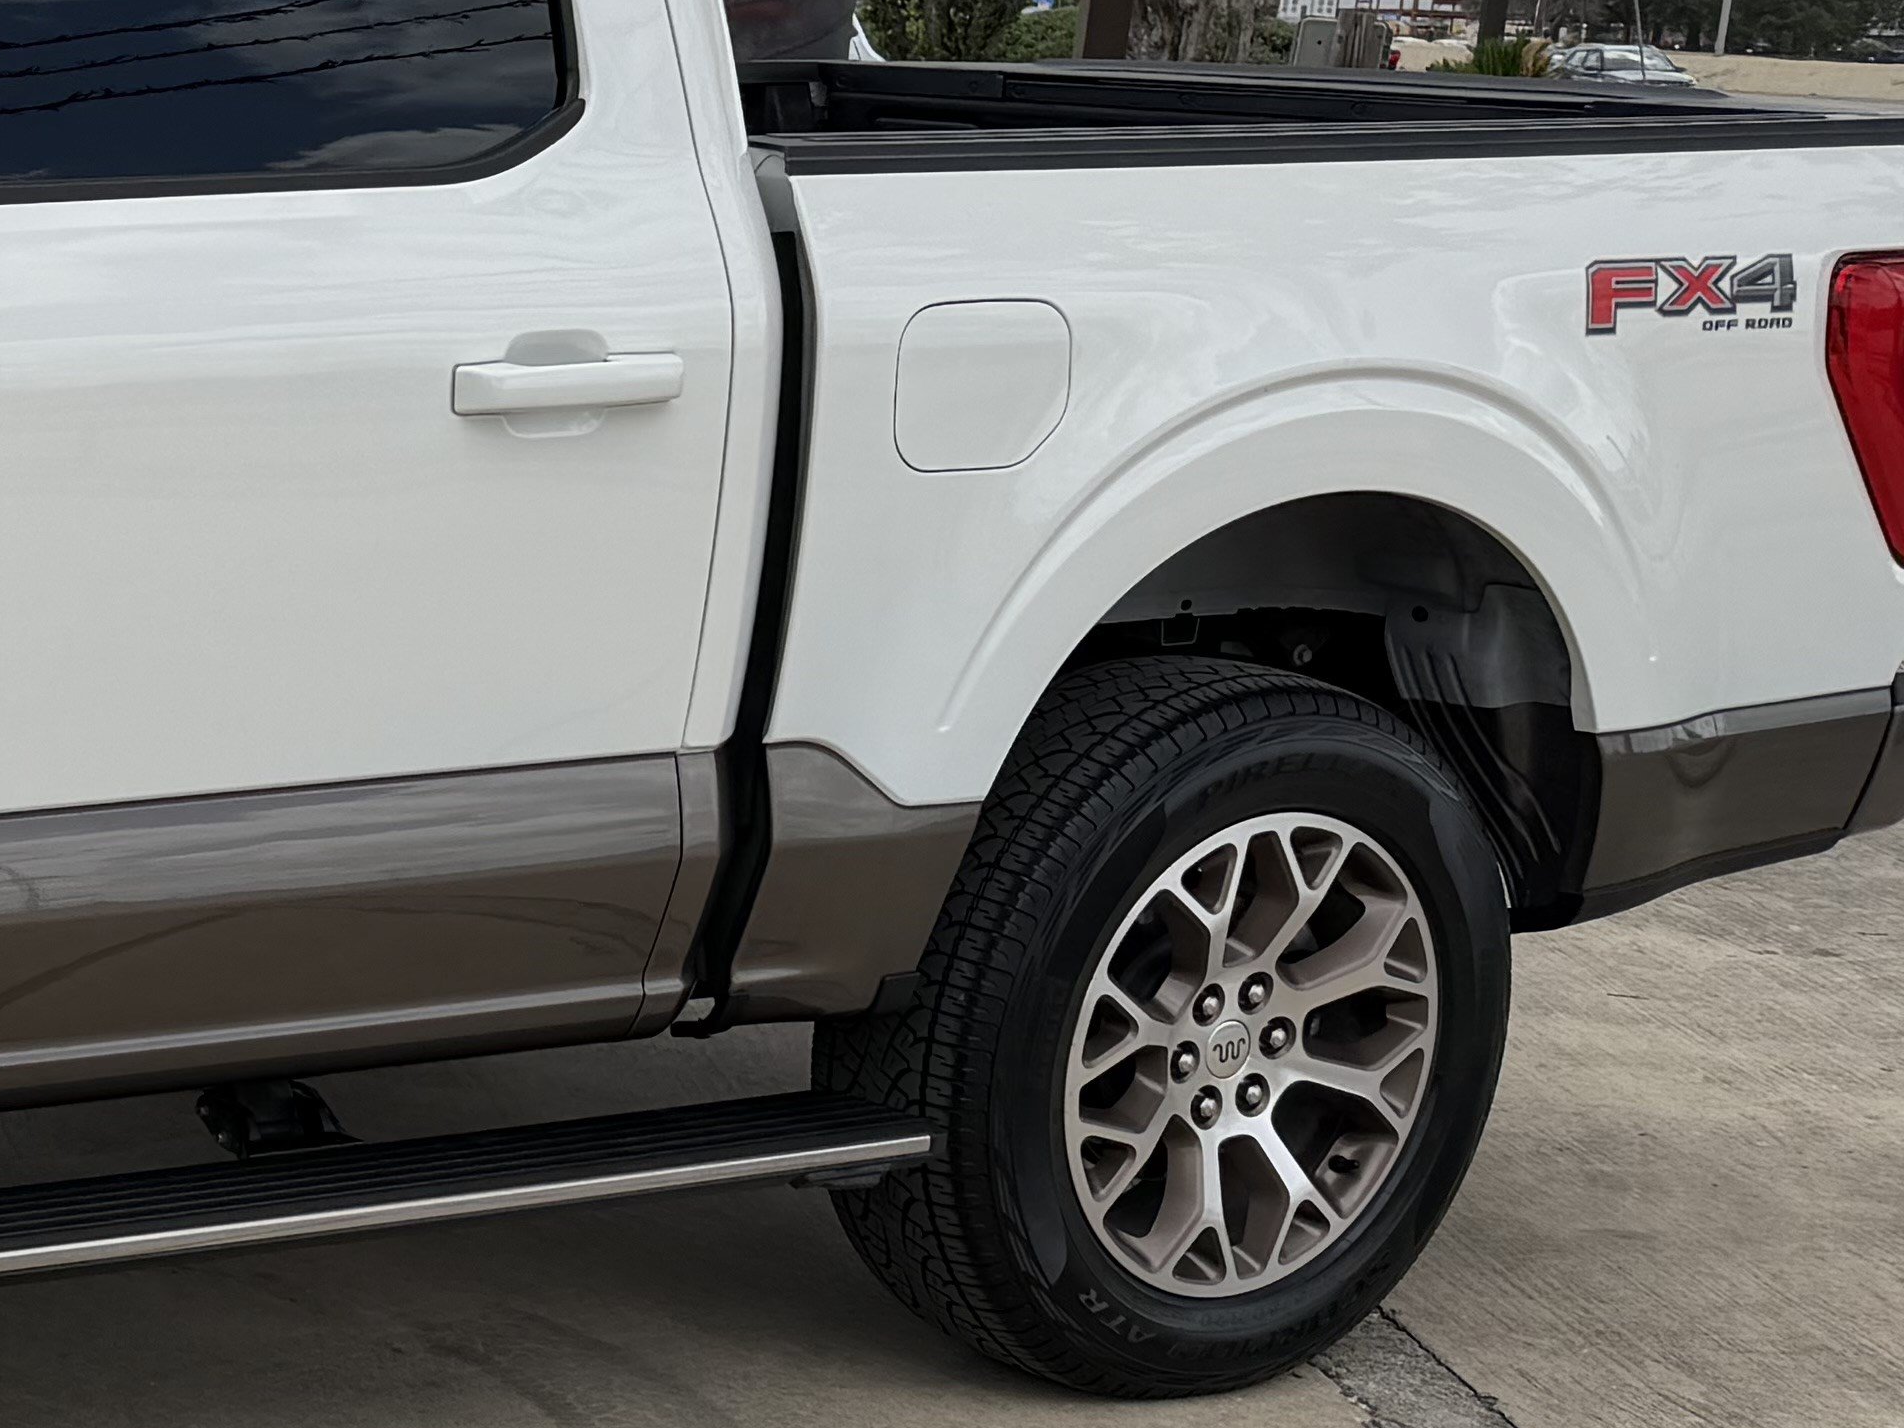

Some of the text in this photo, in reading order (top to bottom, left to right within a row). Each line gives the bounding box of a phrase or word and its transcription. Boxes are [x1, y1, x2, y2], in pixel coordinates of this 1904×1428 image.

[1585, 253, 1797, 337] FX4
[1702, 316, 1793, 332] OFF ROAD
[1077, 1287, 1160, 1344] ATR
